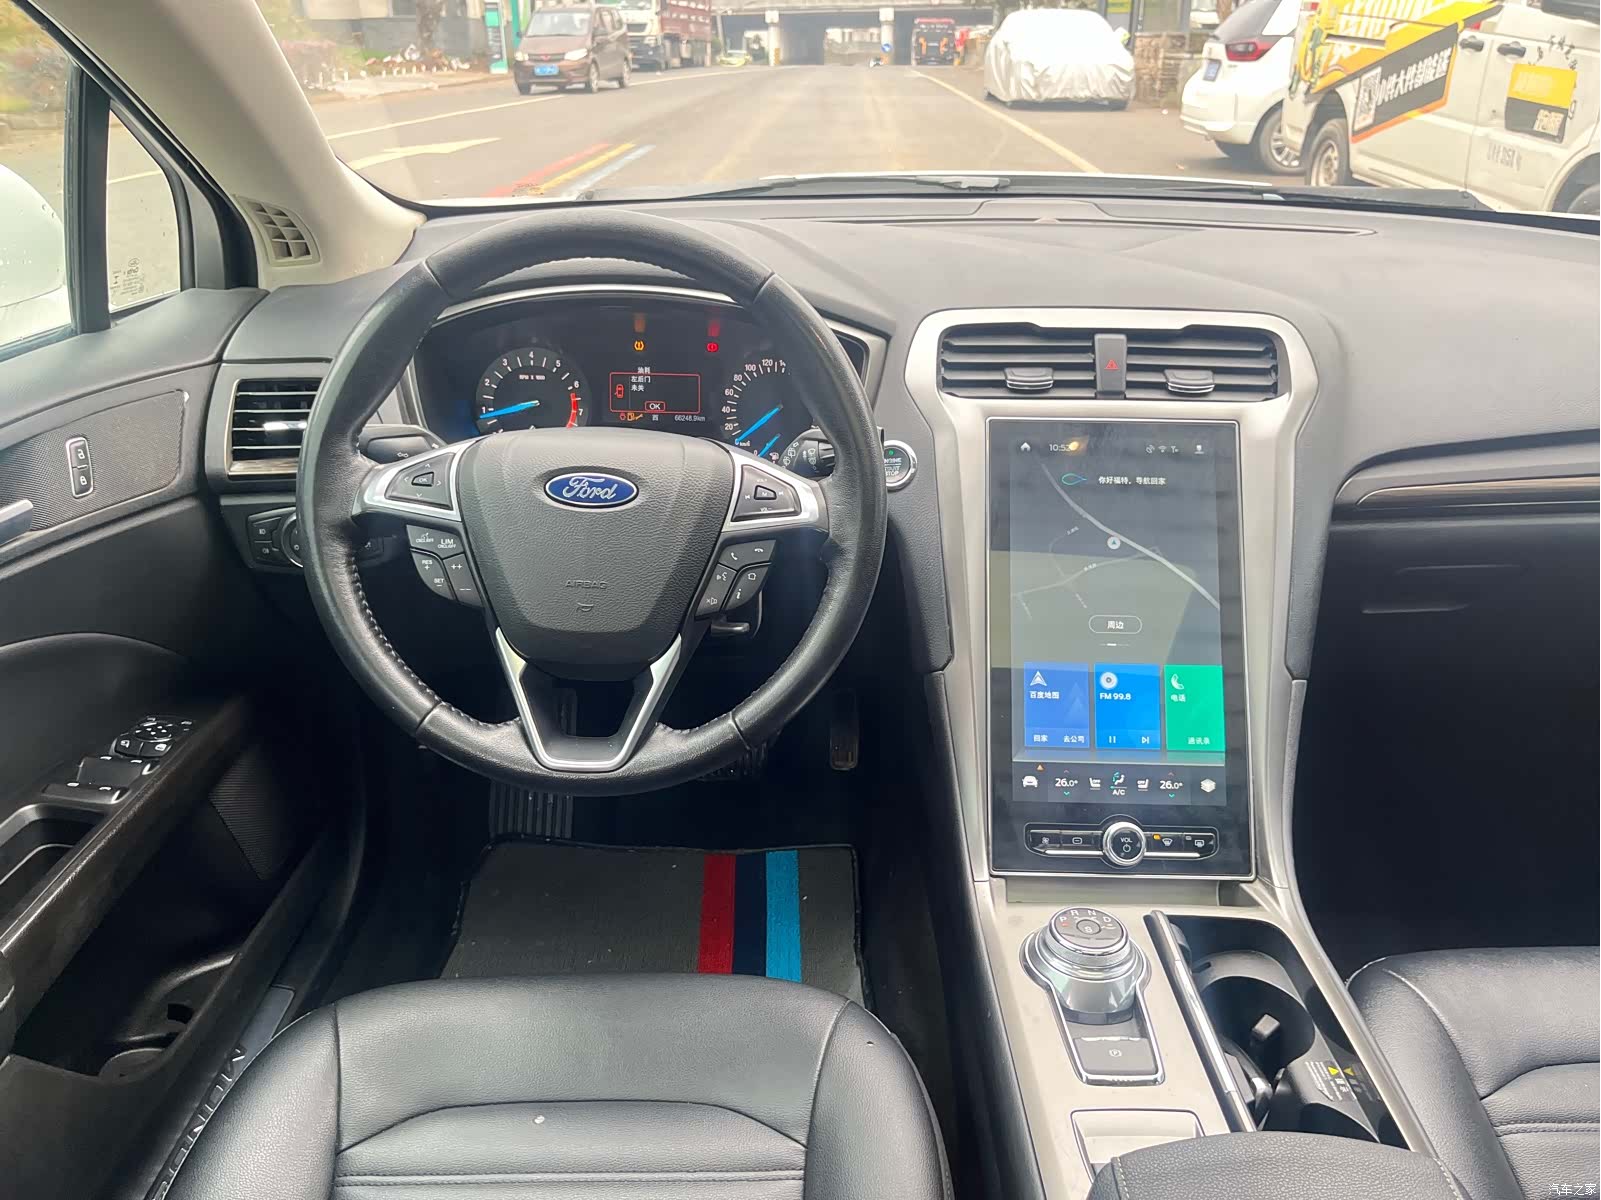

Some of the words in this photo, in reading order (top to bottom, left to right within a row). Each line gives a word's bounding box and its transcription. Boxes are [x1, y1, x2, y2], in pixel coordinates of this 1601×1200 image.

[502, 358, 508, 366] 3
[762, 358, 773, 367] 120
[631, 375, 651, 383] 左后门
[733, 373, 743, 381] 80
[631, 384, 645, 392] 未关
[724, 388, 734, 396] 60
[724, 422, 734, 430] 20
[562, 476, 619, 500] Ford
[565, 580, 608, 590] AIRBAG
[1107, 620, 1125, 630] 周边
[1029, 690, 1060, 700] 百度地图
[1099, 692, 1112, 700] FM
[1113, 692, 1132, 701] 99.8
[1170, 693, 1186, 703] 电话
[1033, 734, 1049, 743] 回家
[1063, 735, 1085, 744] 去公司
[1187, 736, 1211, 746] 通讯录
